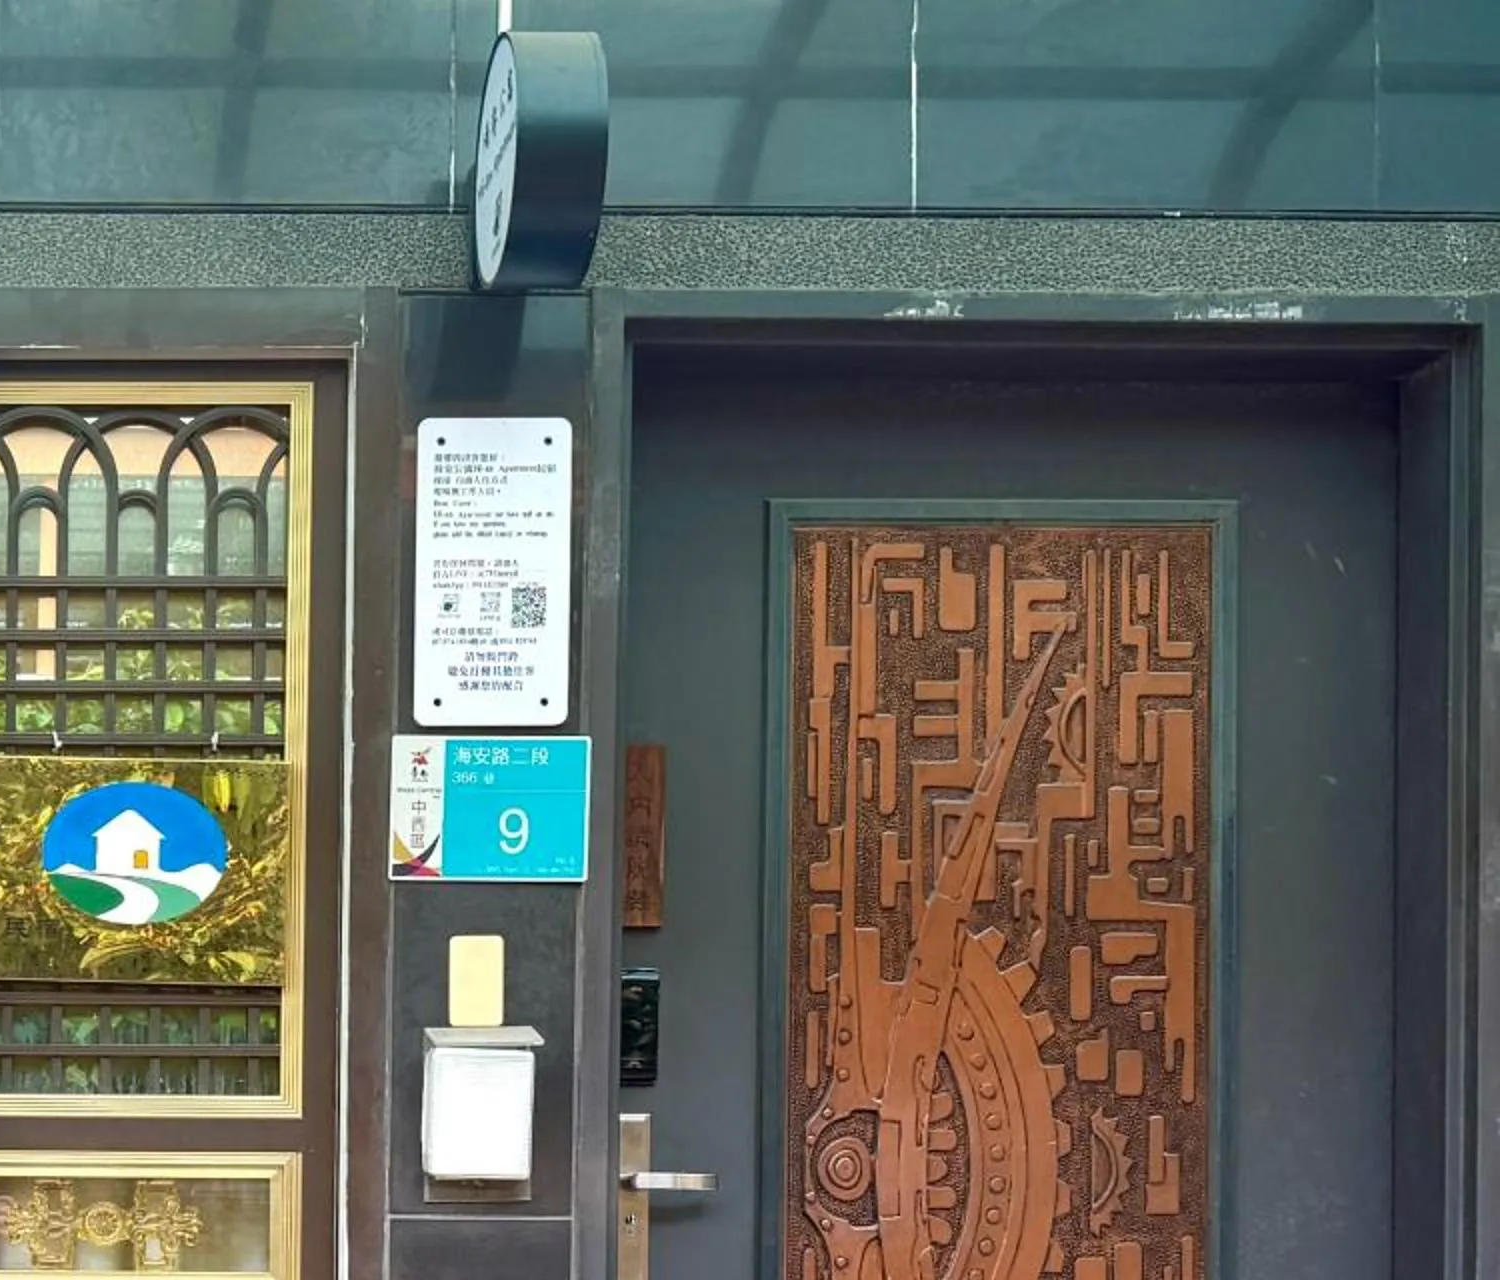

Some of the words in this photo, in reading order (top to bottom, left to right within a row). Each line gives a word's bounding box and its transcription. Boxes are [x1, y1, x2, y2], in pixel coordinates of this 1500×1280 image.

[453, 746, 549, 766] 海安路二段
[451, 771, 477, 785] 366
[499, 808, 529, 855] 9
